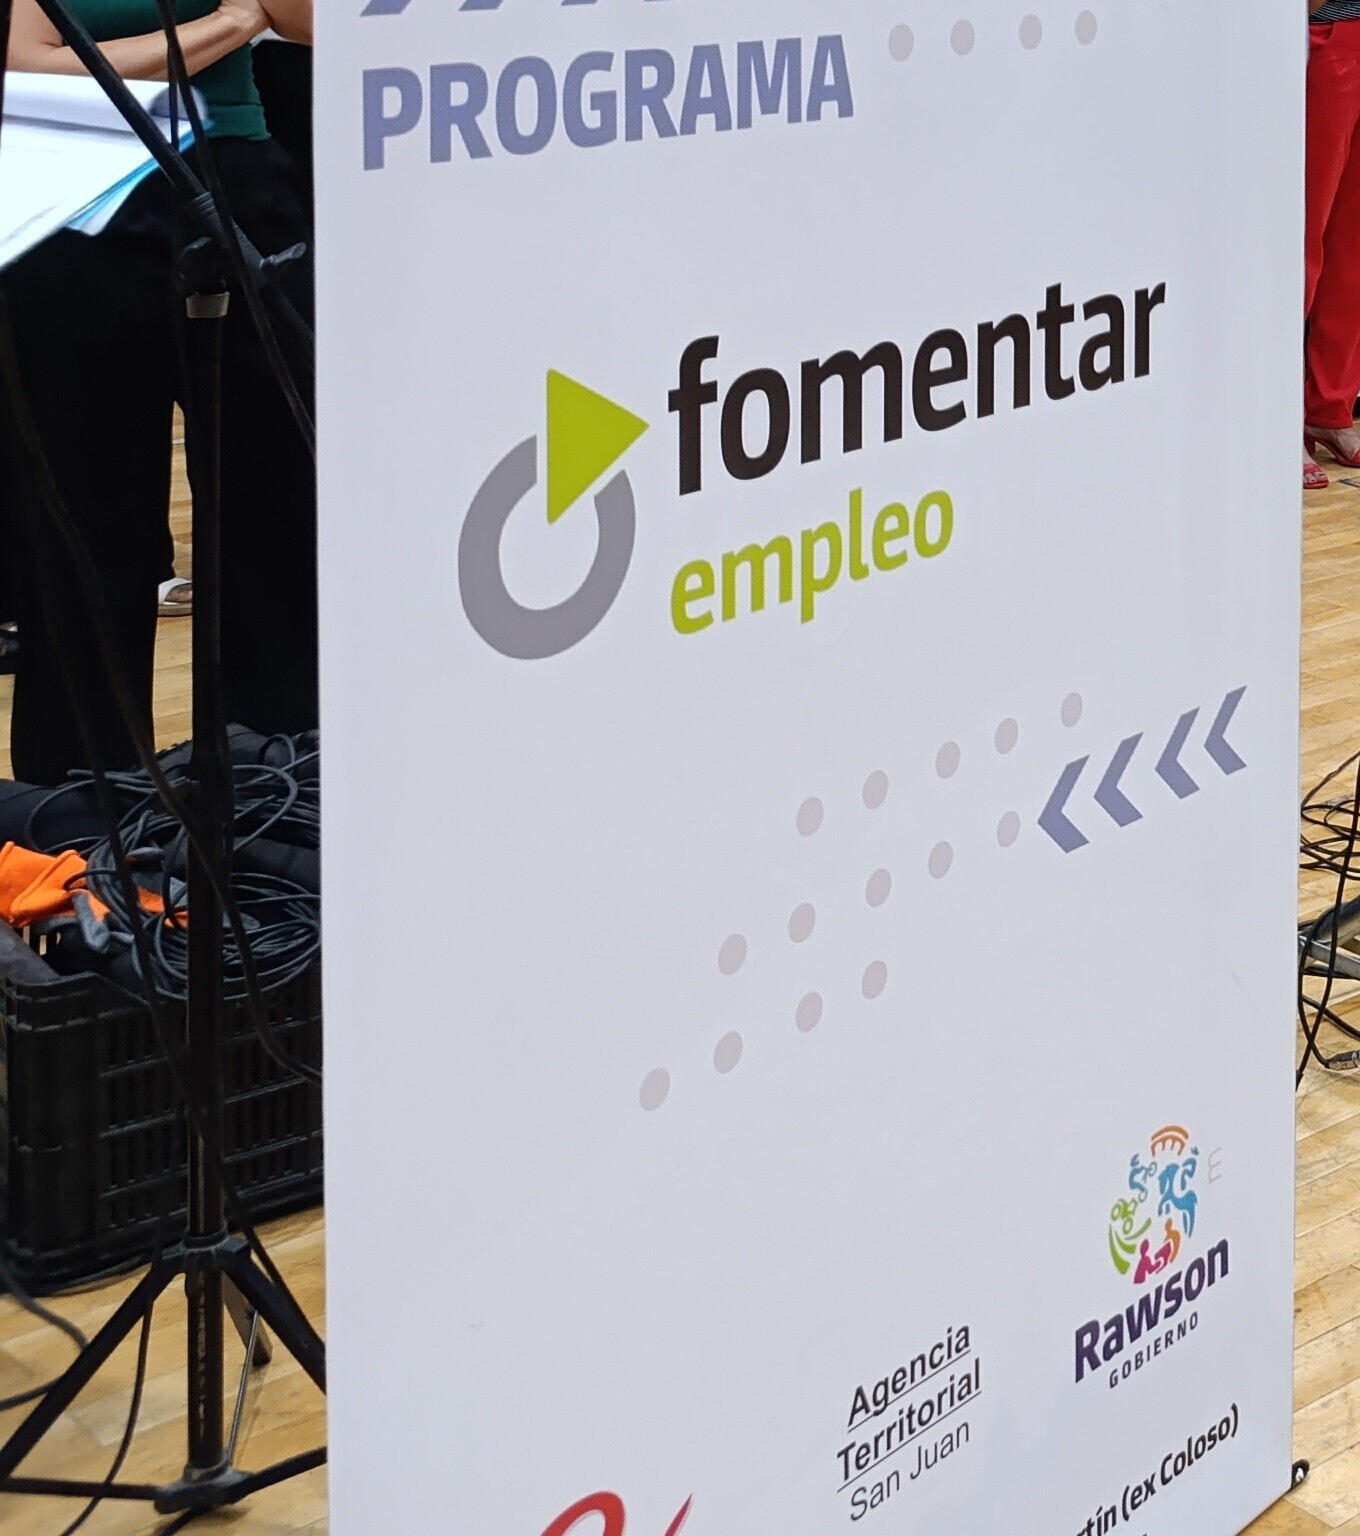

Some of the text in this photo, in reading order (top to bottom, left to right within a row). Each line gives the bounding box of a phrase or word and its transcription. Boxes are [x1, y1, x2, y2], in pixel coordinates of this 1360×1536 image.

[362, 33, 854, 171] PROGRAMA
[668, 280, 1166, 497] fomentar
[669, 487, 954, 635] empleo
[847, 1322, 971, 1428] Agencia
[1074, 1238, 1229, 1385] Rawson
[1108, 1311, 1198, 1390] GOBIERNO
[837, 1357, 981, 1484] Territorial
[850, 1420, 971, 1523] San Juan
[1122, 1472, 1156, 1521] (ex
[1160, 1402, 1239, 1486] Coloso)
